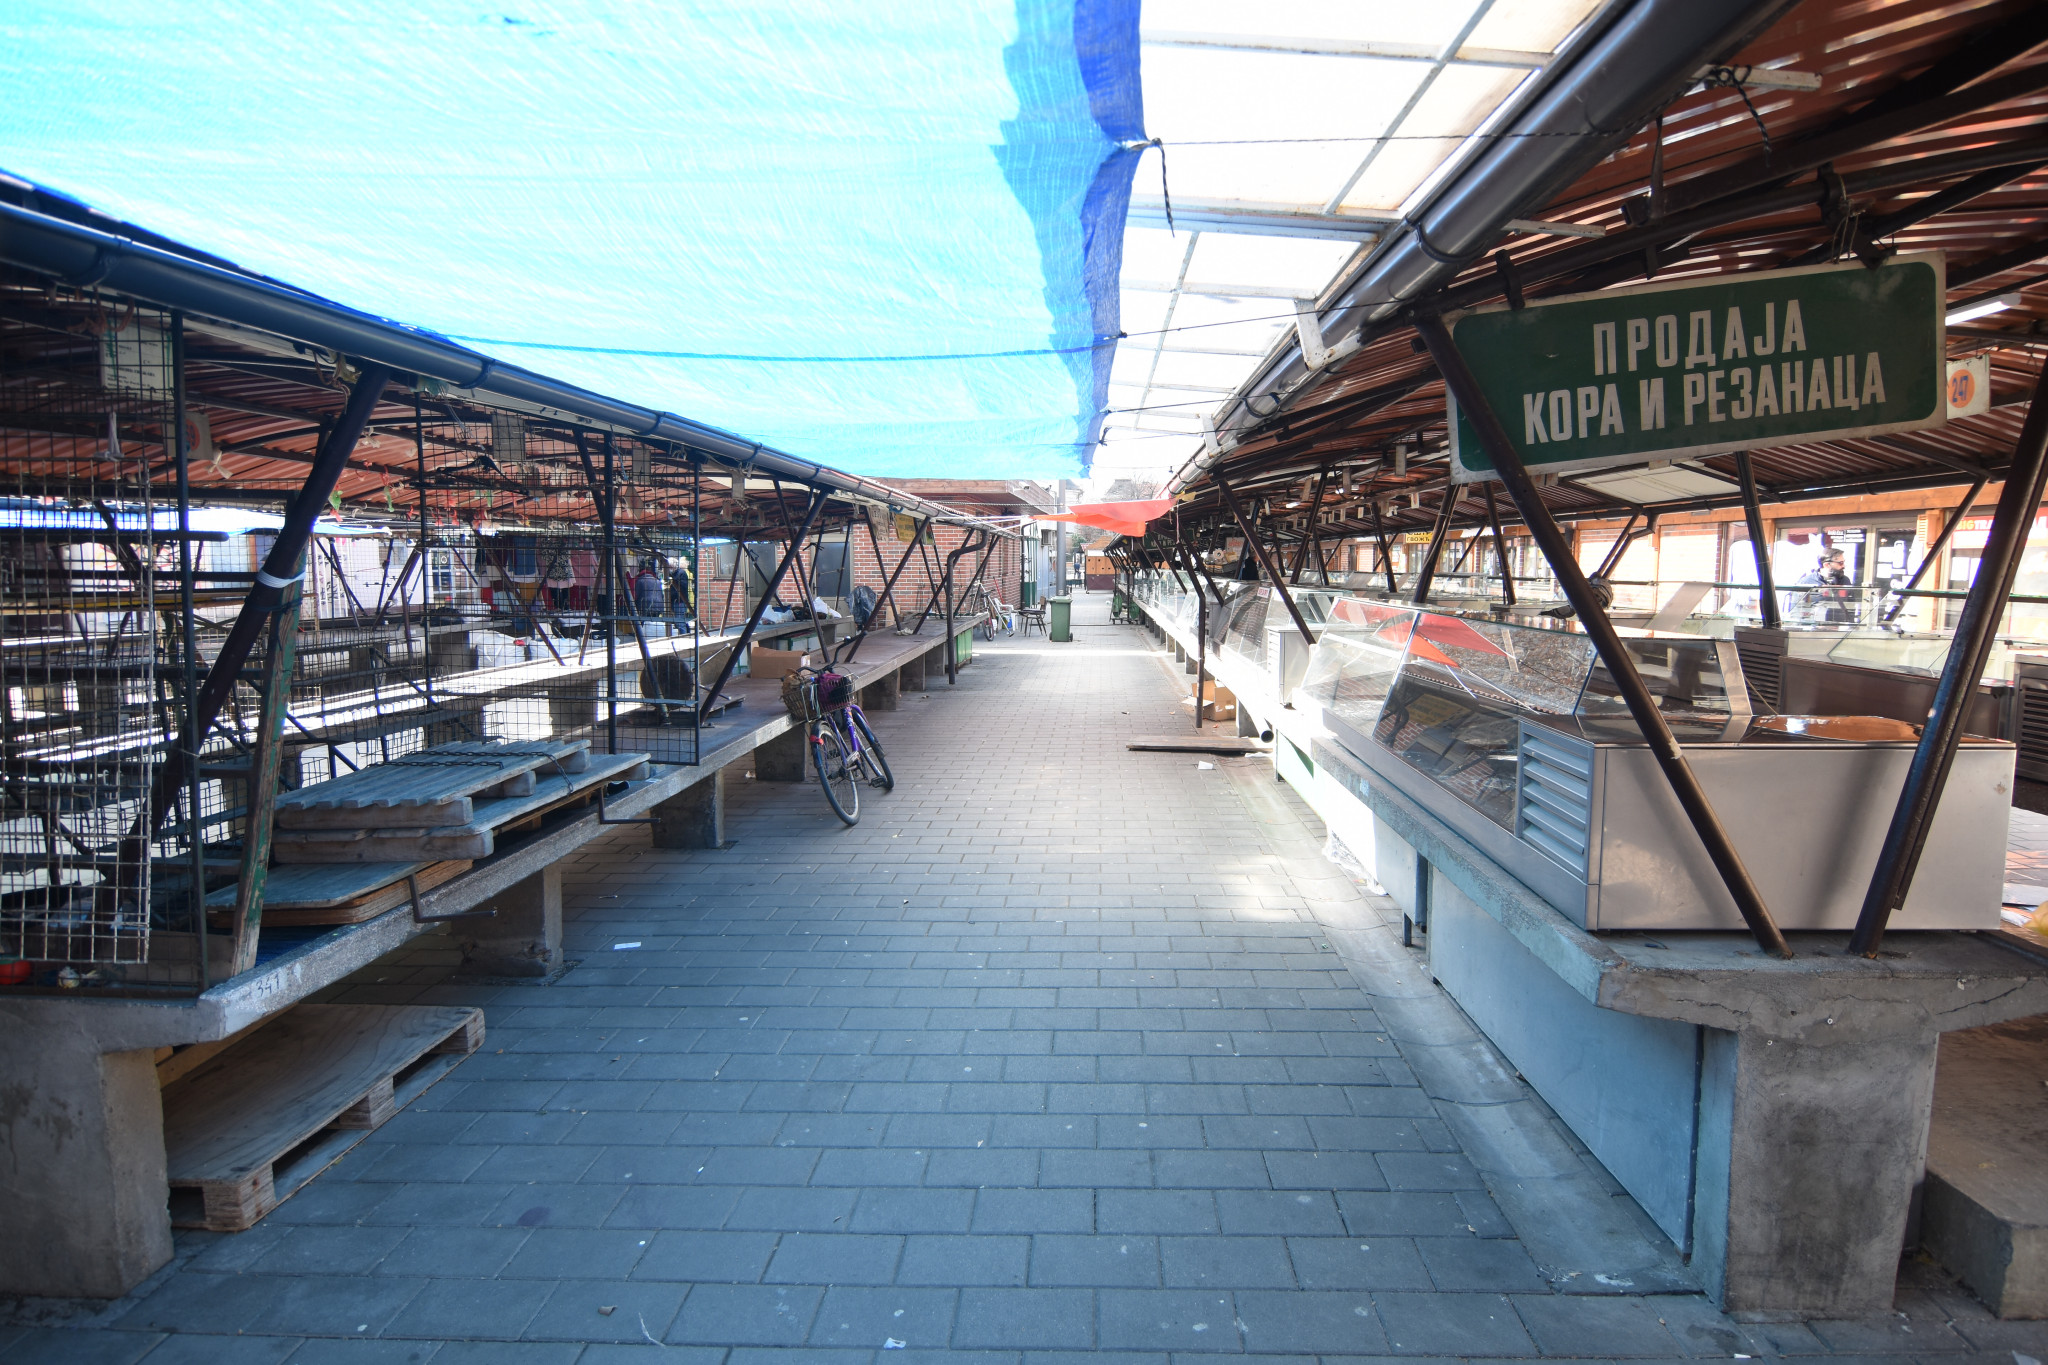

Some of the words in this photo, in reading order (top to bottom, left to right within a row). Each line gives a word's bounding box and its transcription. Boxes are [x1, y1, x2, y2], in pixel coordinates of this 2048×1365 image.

[1593, 299, 1807, 376] ПРОДАЈА
[1523, 383, 1625, 445] КОРА
[1639, 377, 1665, 432] И
[1683, 352, 1886, 426] РЕЗАНАЦА
